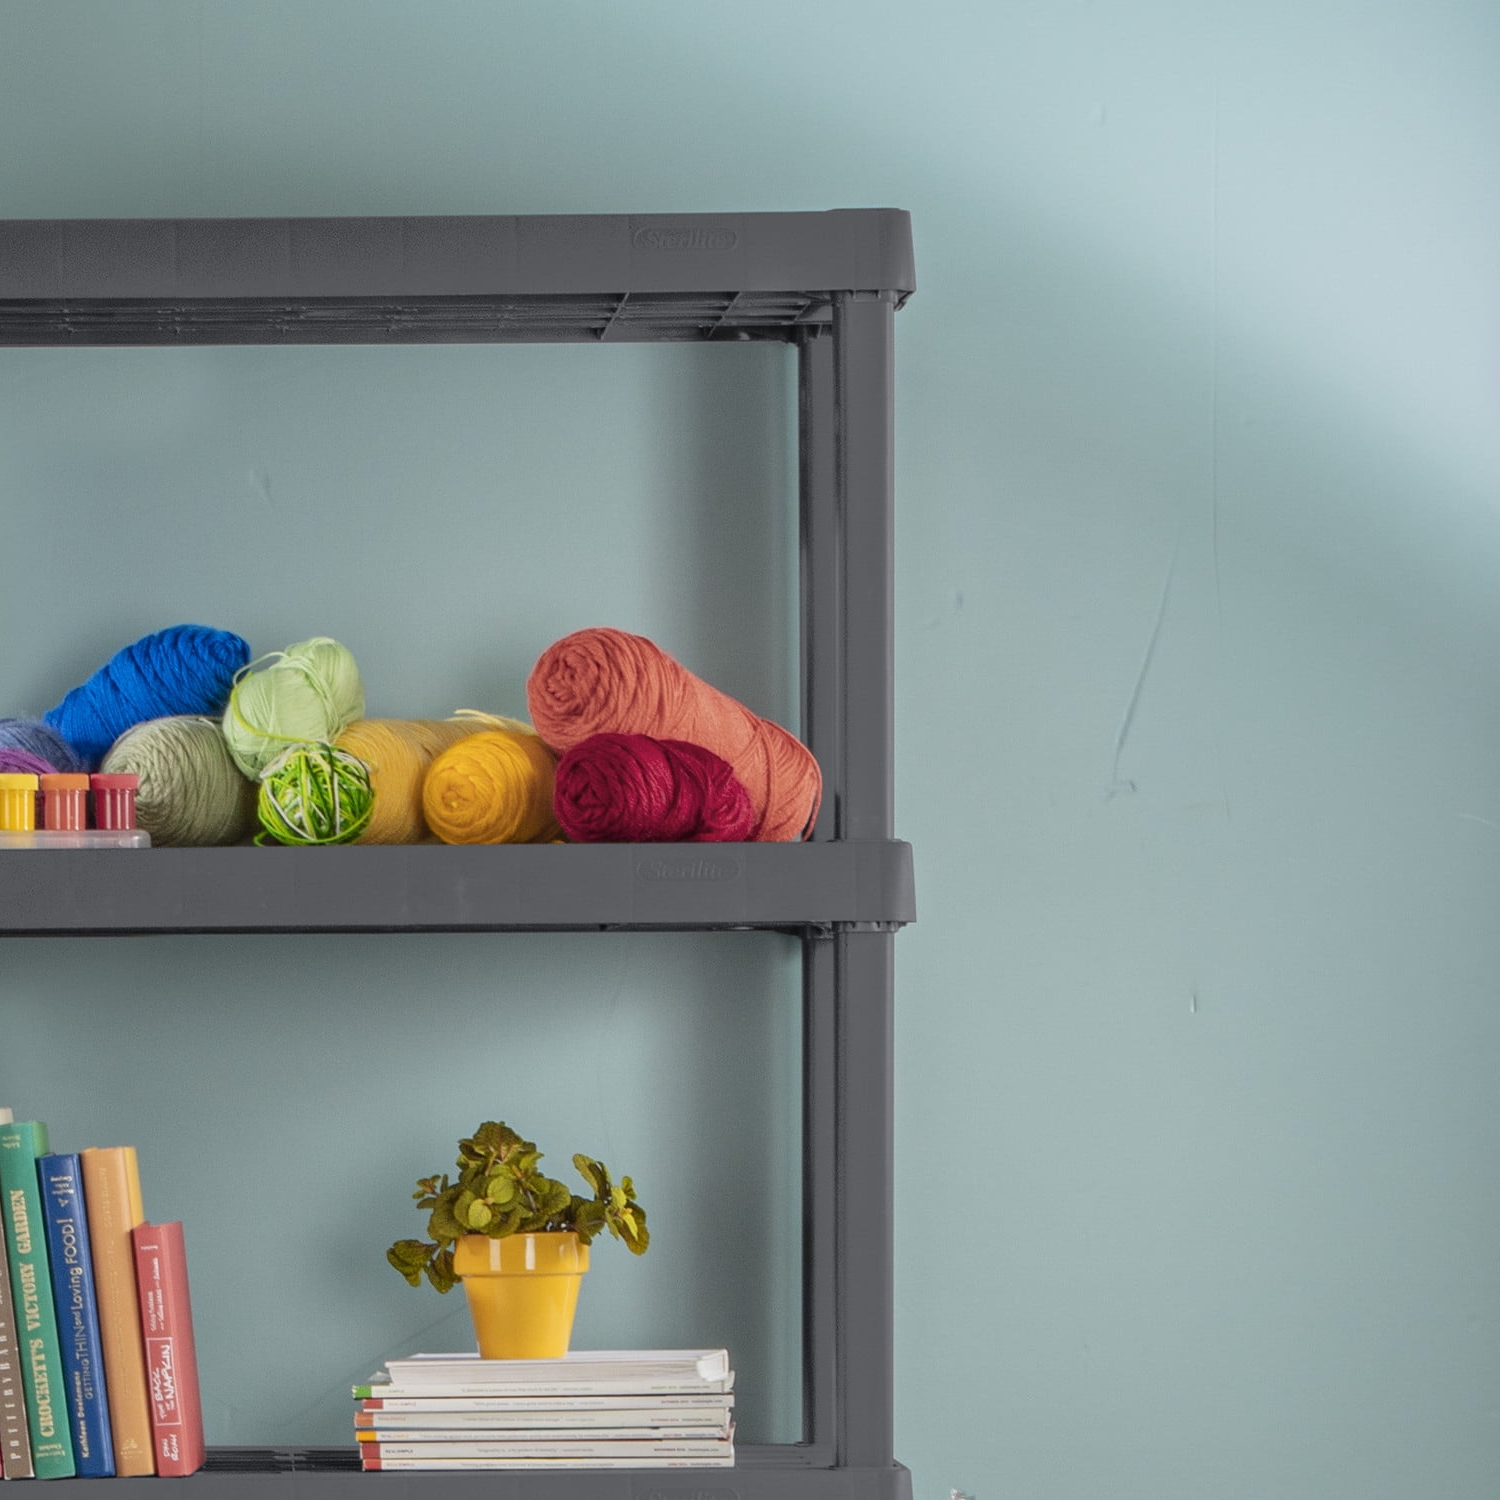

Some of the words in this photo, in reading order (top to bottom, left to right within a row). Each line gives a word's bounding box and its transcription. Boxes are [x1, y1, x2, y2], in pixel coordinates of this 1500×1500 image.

[9, 1189, 33, 1255] GARDEN
[56, 1217, 78, 1265] FOOD!
[19, 1262, 42, 1332] VICTORY
[68, 1266, 84, 1310] Loving
[75, 1326, 88, 1359] THIN
[30, 1338, 55, 1438] CROCKETT'S
[81, 1358, 94, 1400] GETTING
[152, 1367, 166, 1402] BACK
[160, 1343, 176, 1400] NAPKIN
[78, 1419, 90, 1459] Kathleen
